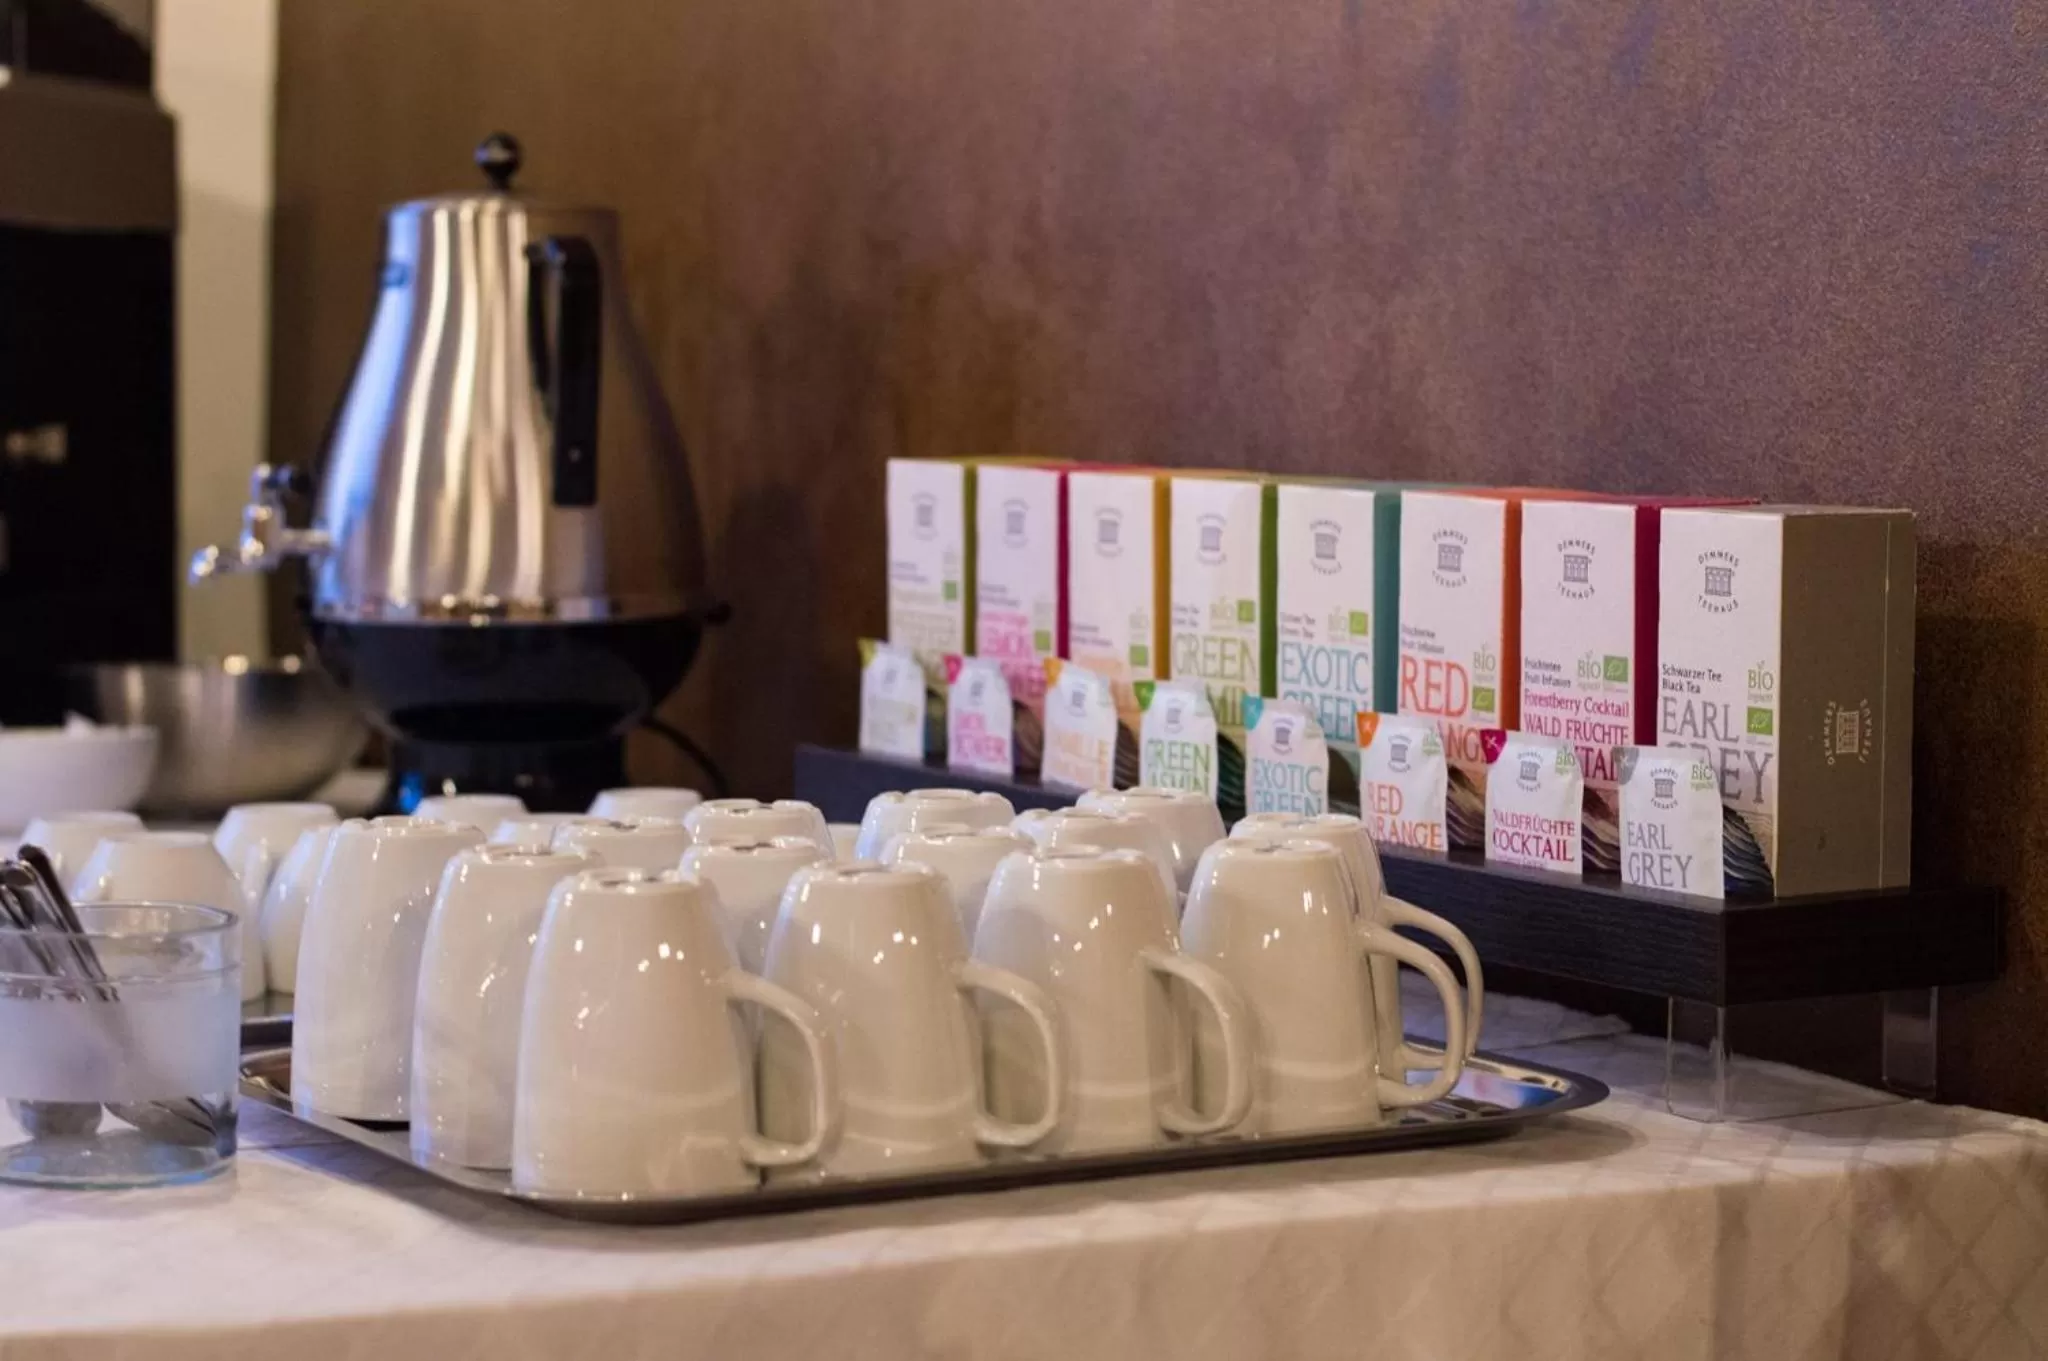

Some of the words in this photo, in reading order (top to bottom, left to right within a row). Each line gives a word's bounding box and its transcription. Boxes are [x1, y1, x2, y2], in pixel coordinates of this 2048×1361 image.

[1280, 641, 1369, 695] EXOTIC
[1577, 659, 1602, 680] BIO
[1662, 663, 1706, 681] Schwarzer
[1707, 669, 1723, 683] Tee
[1747, 669, 1774, 691] BIO
[1401, 653, 1469, 718] RED
[1662, 678, 1684, 693] Black
[1687, 681, 1701, 694] Tea
[1524, 688, 1581, 716] Forestberry
[1583, 696, 1630, 718] Cocktail
[1524, 713, 1562, 738] WALD
[1661, 696, 1740, 744] EARL
[1626, 820, 1673, 851] EARL
[1627, 851, 1693, 889] GREY
